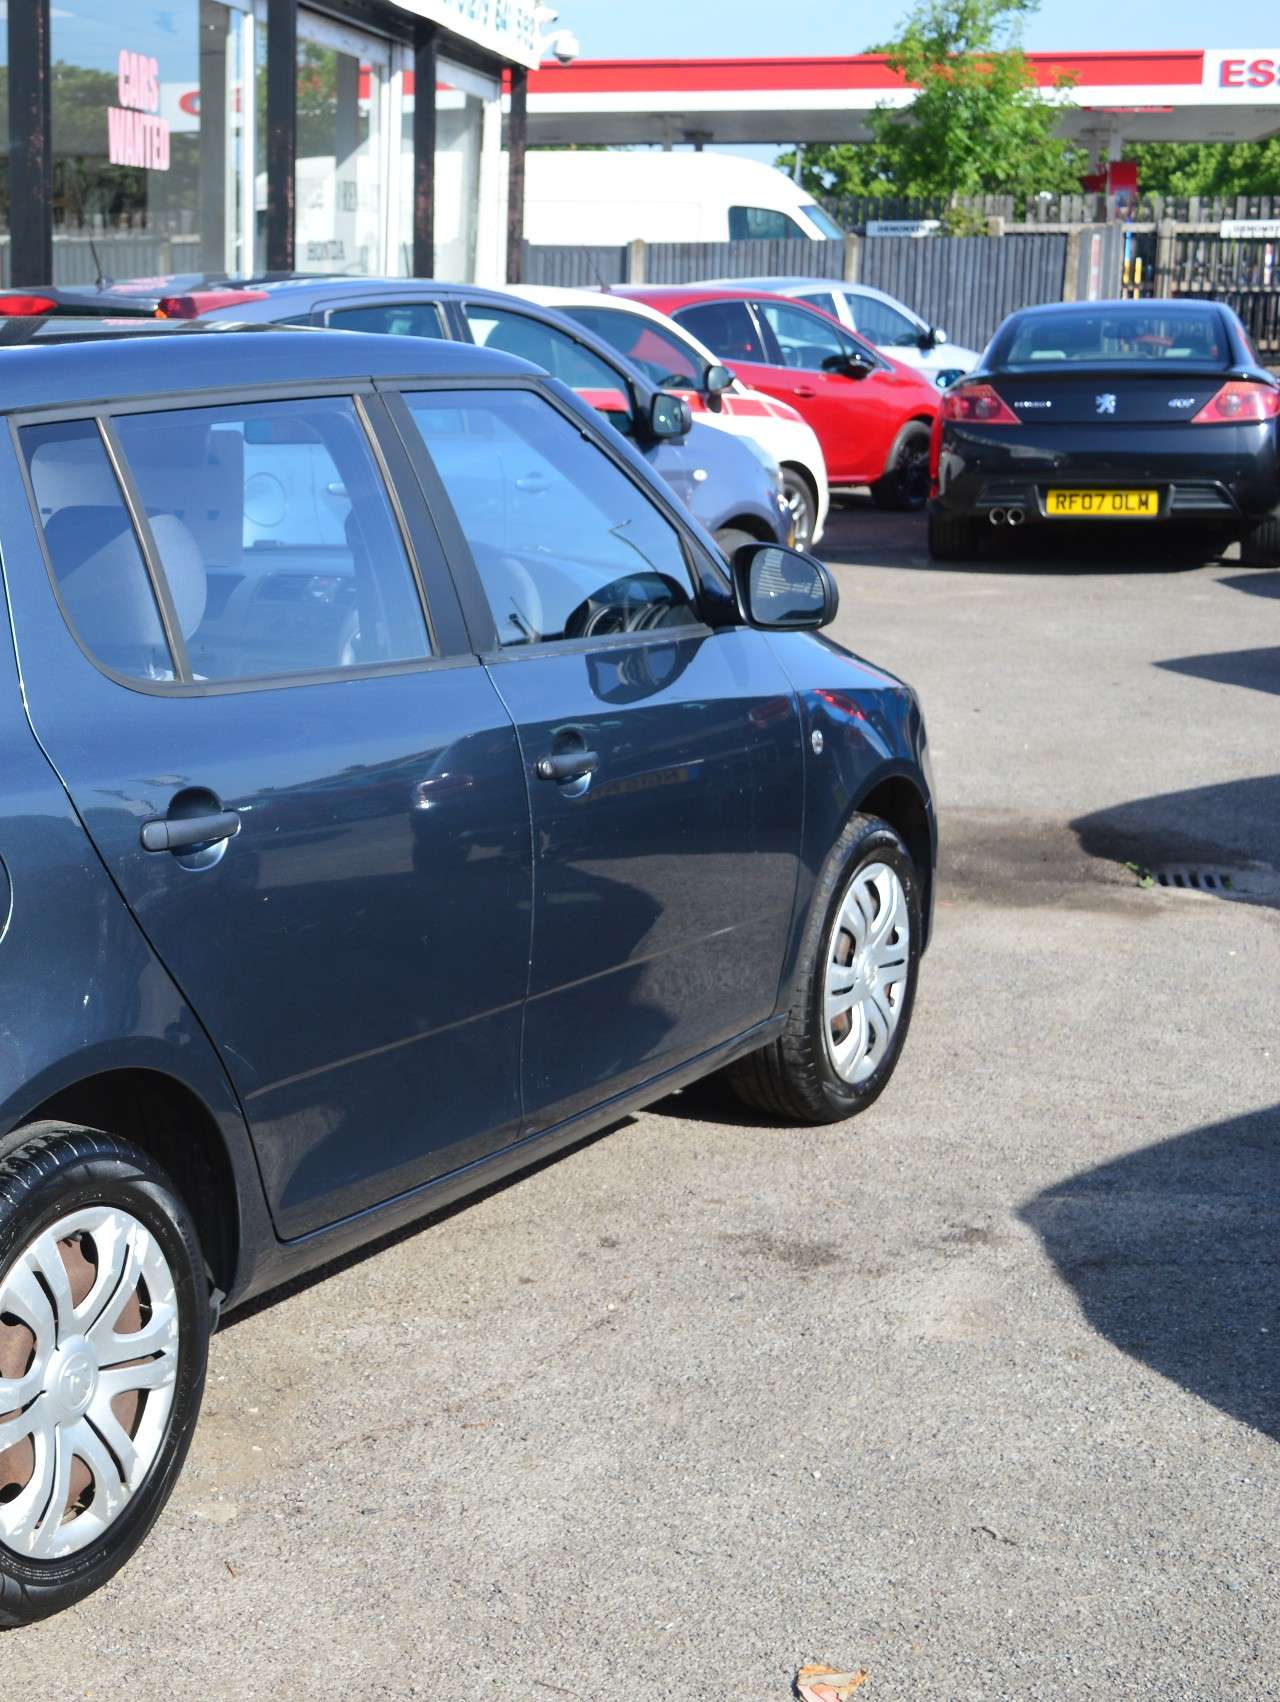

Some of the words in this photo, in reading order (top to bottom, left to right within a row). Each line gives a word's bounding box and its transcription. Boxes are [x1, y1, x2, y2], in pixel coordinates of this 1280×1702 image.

[118, 49, 159, 112] CARS
[1219, 59, 1280, 88] ES
[108, 106, 169, 171] WANTED
[1055, 493, 1105, 510] RF07
[1112, 493, 1149, 510] OLM
